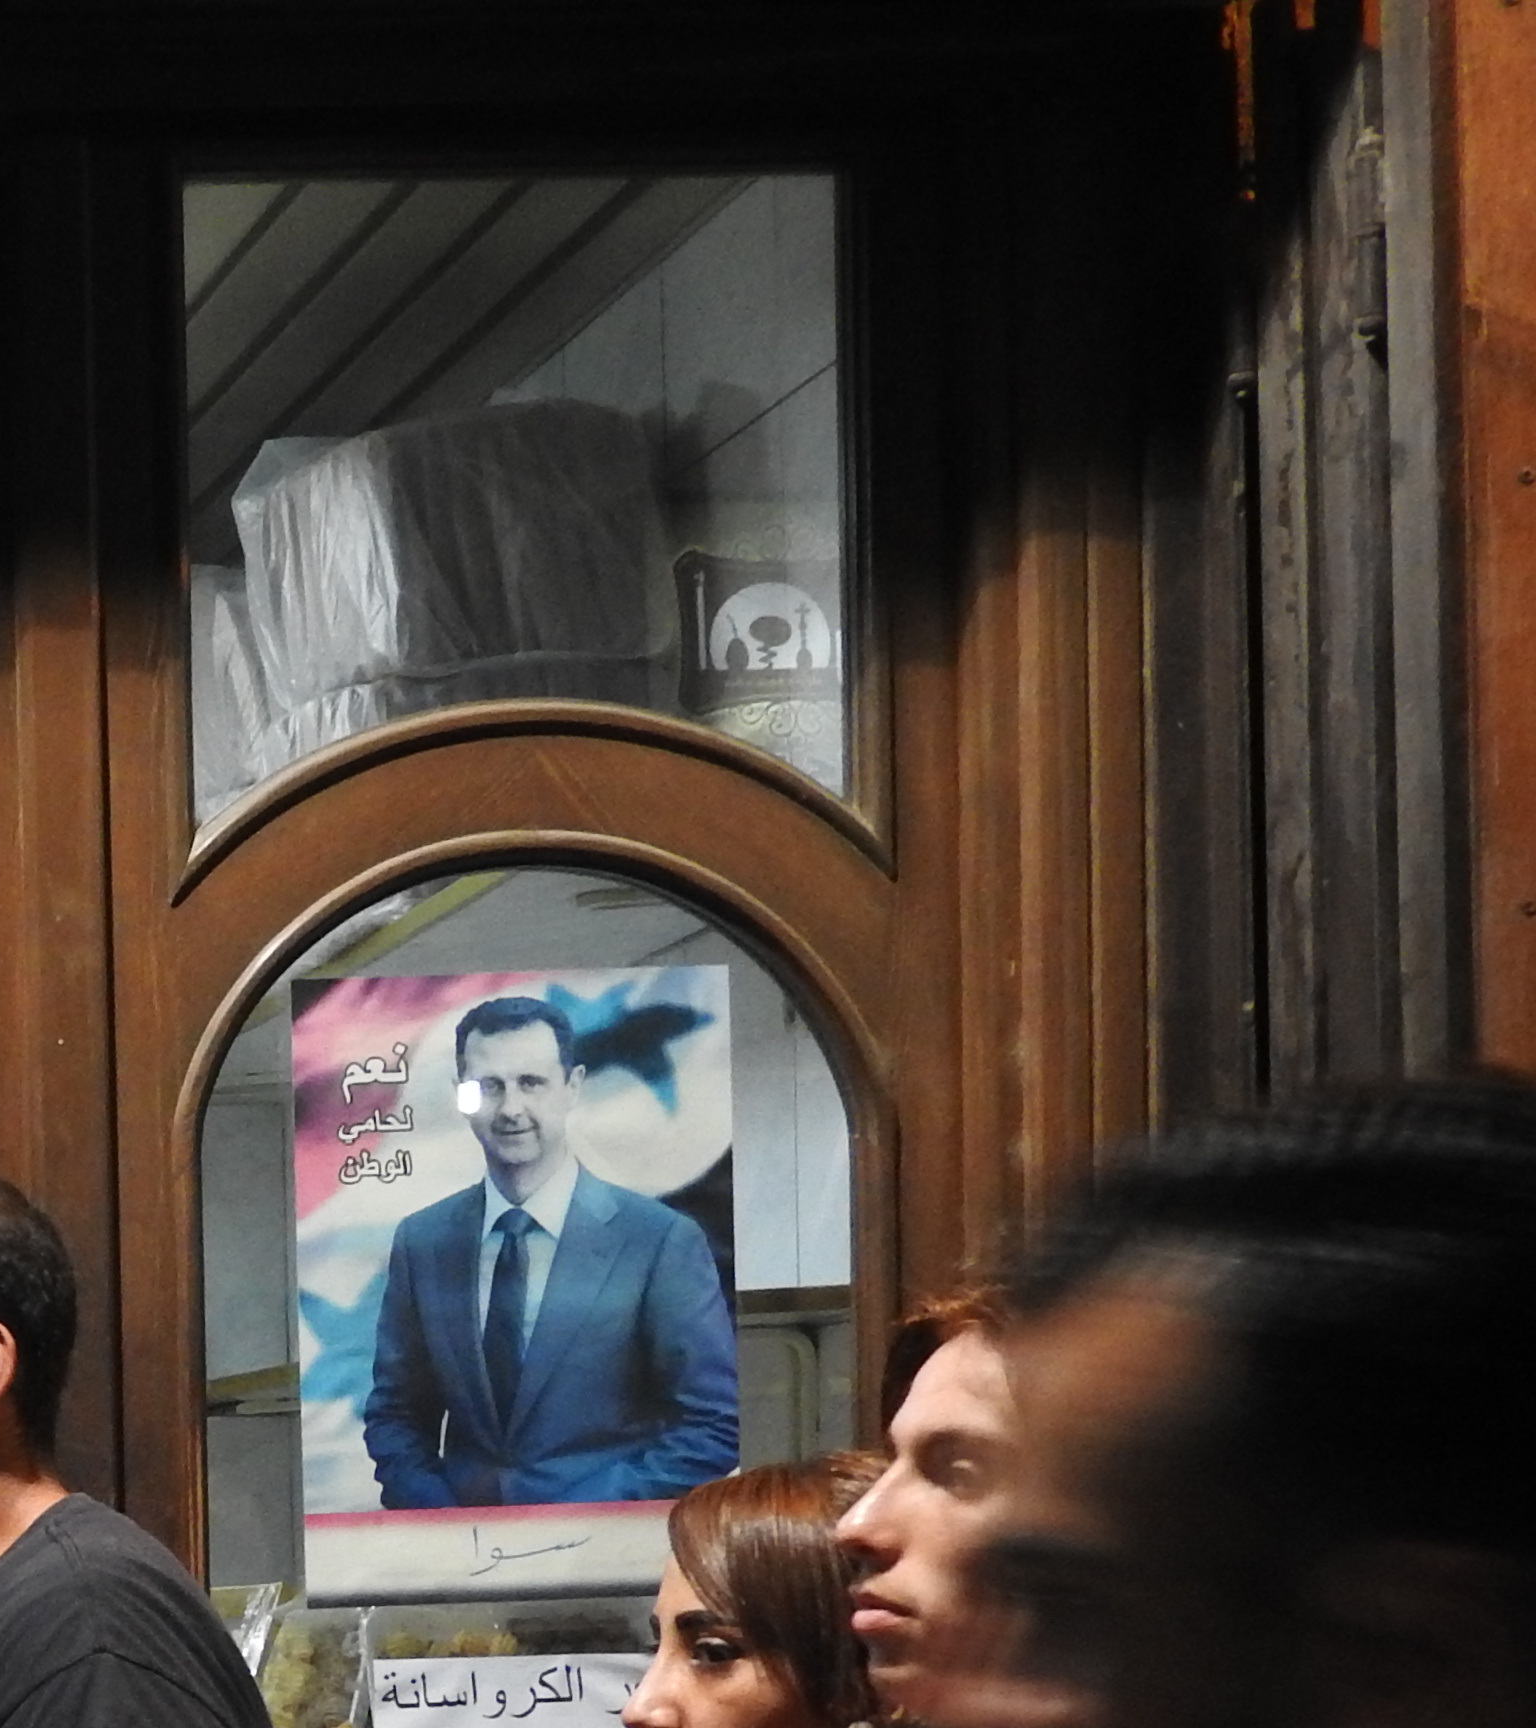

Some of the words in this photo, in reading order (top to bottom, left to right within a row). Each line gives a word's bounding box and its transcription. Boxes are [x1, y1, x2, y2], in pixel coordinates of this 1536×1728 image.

[341, 1040, 409, 1104] نعم
[337, 1105, 414, 1145] لحامي
[338, 1150, 414, 1185] الوطن
